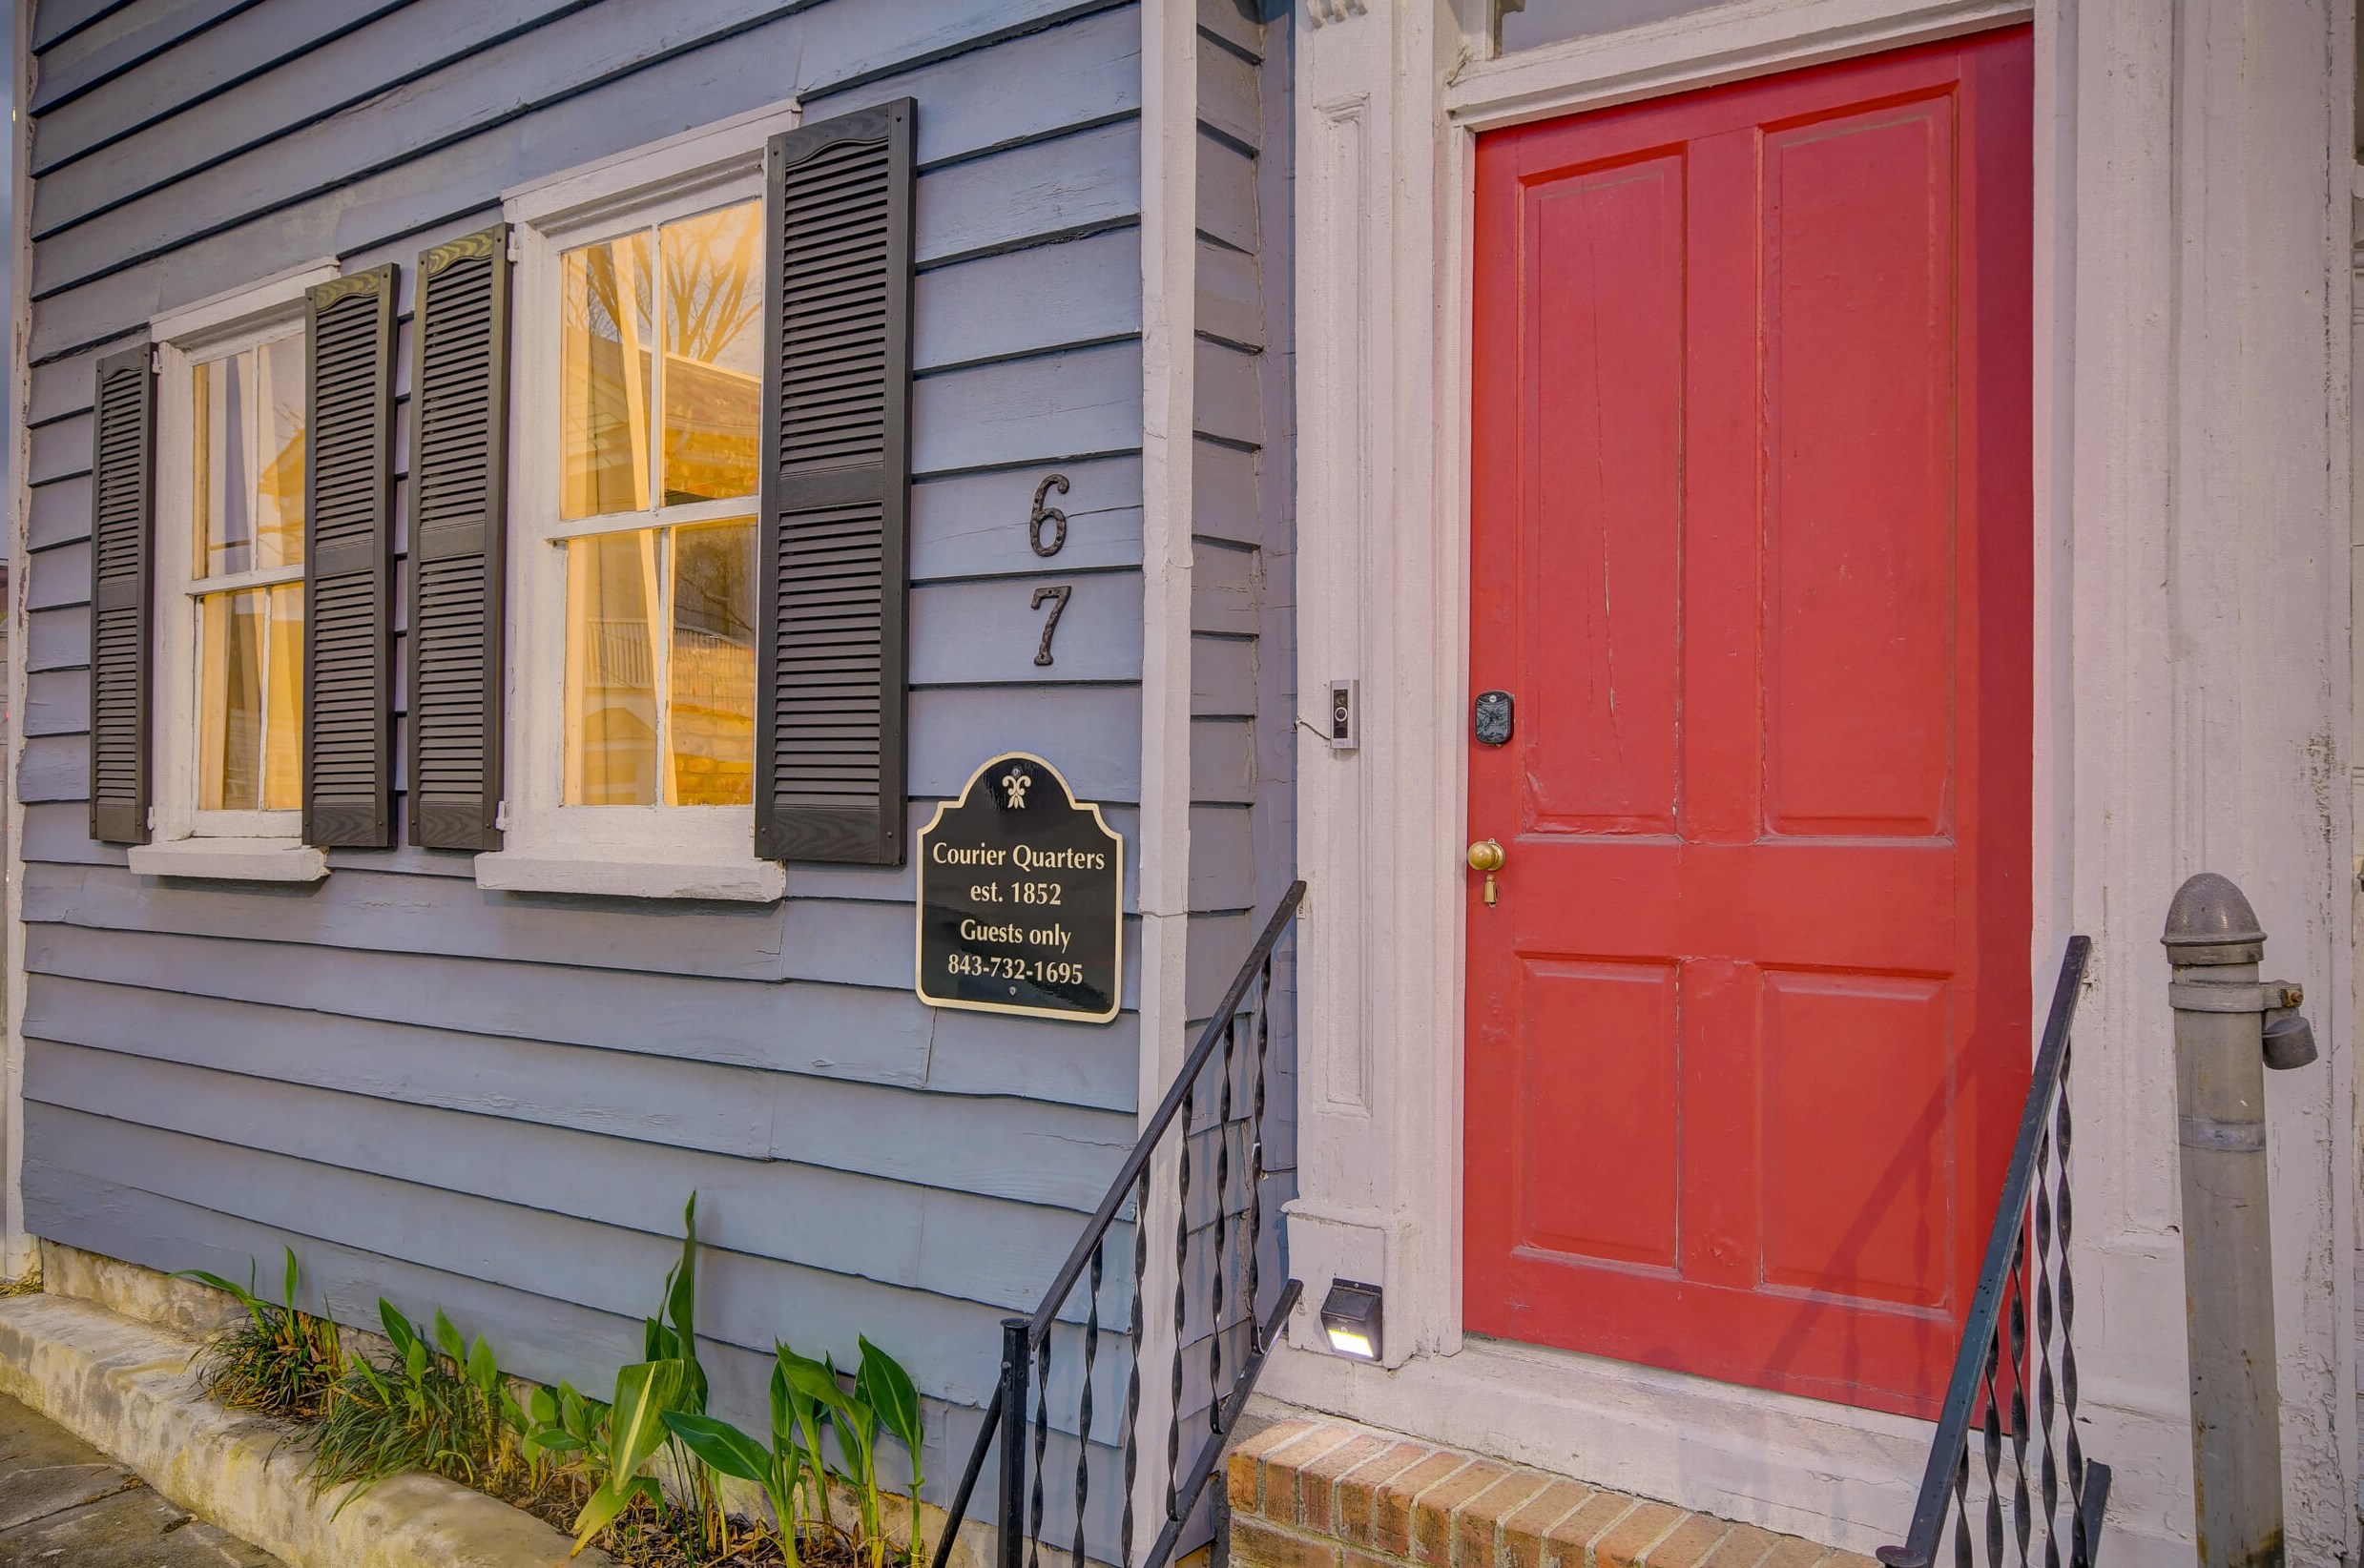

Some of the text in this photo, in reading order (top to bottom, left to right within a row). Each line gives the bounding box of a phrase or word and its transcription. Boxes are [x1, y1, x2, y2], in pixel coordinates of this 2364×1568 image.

[1029, 473, 1069, 557] 6
[1030, 585, 1072, 666] 7
[932, 841, 1105, 872] Courier Quarters
[970, 881, 1062, 905] est. 1852
[960, 918, 1072, 954] Guests only
[947, 954, 1084, 985] 843-732-1695
